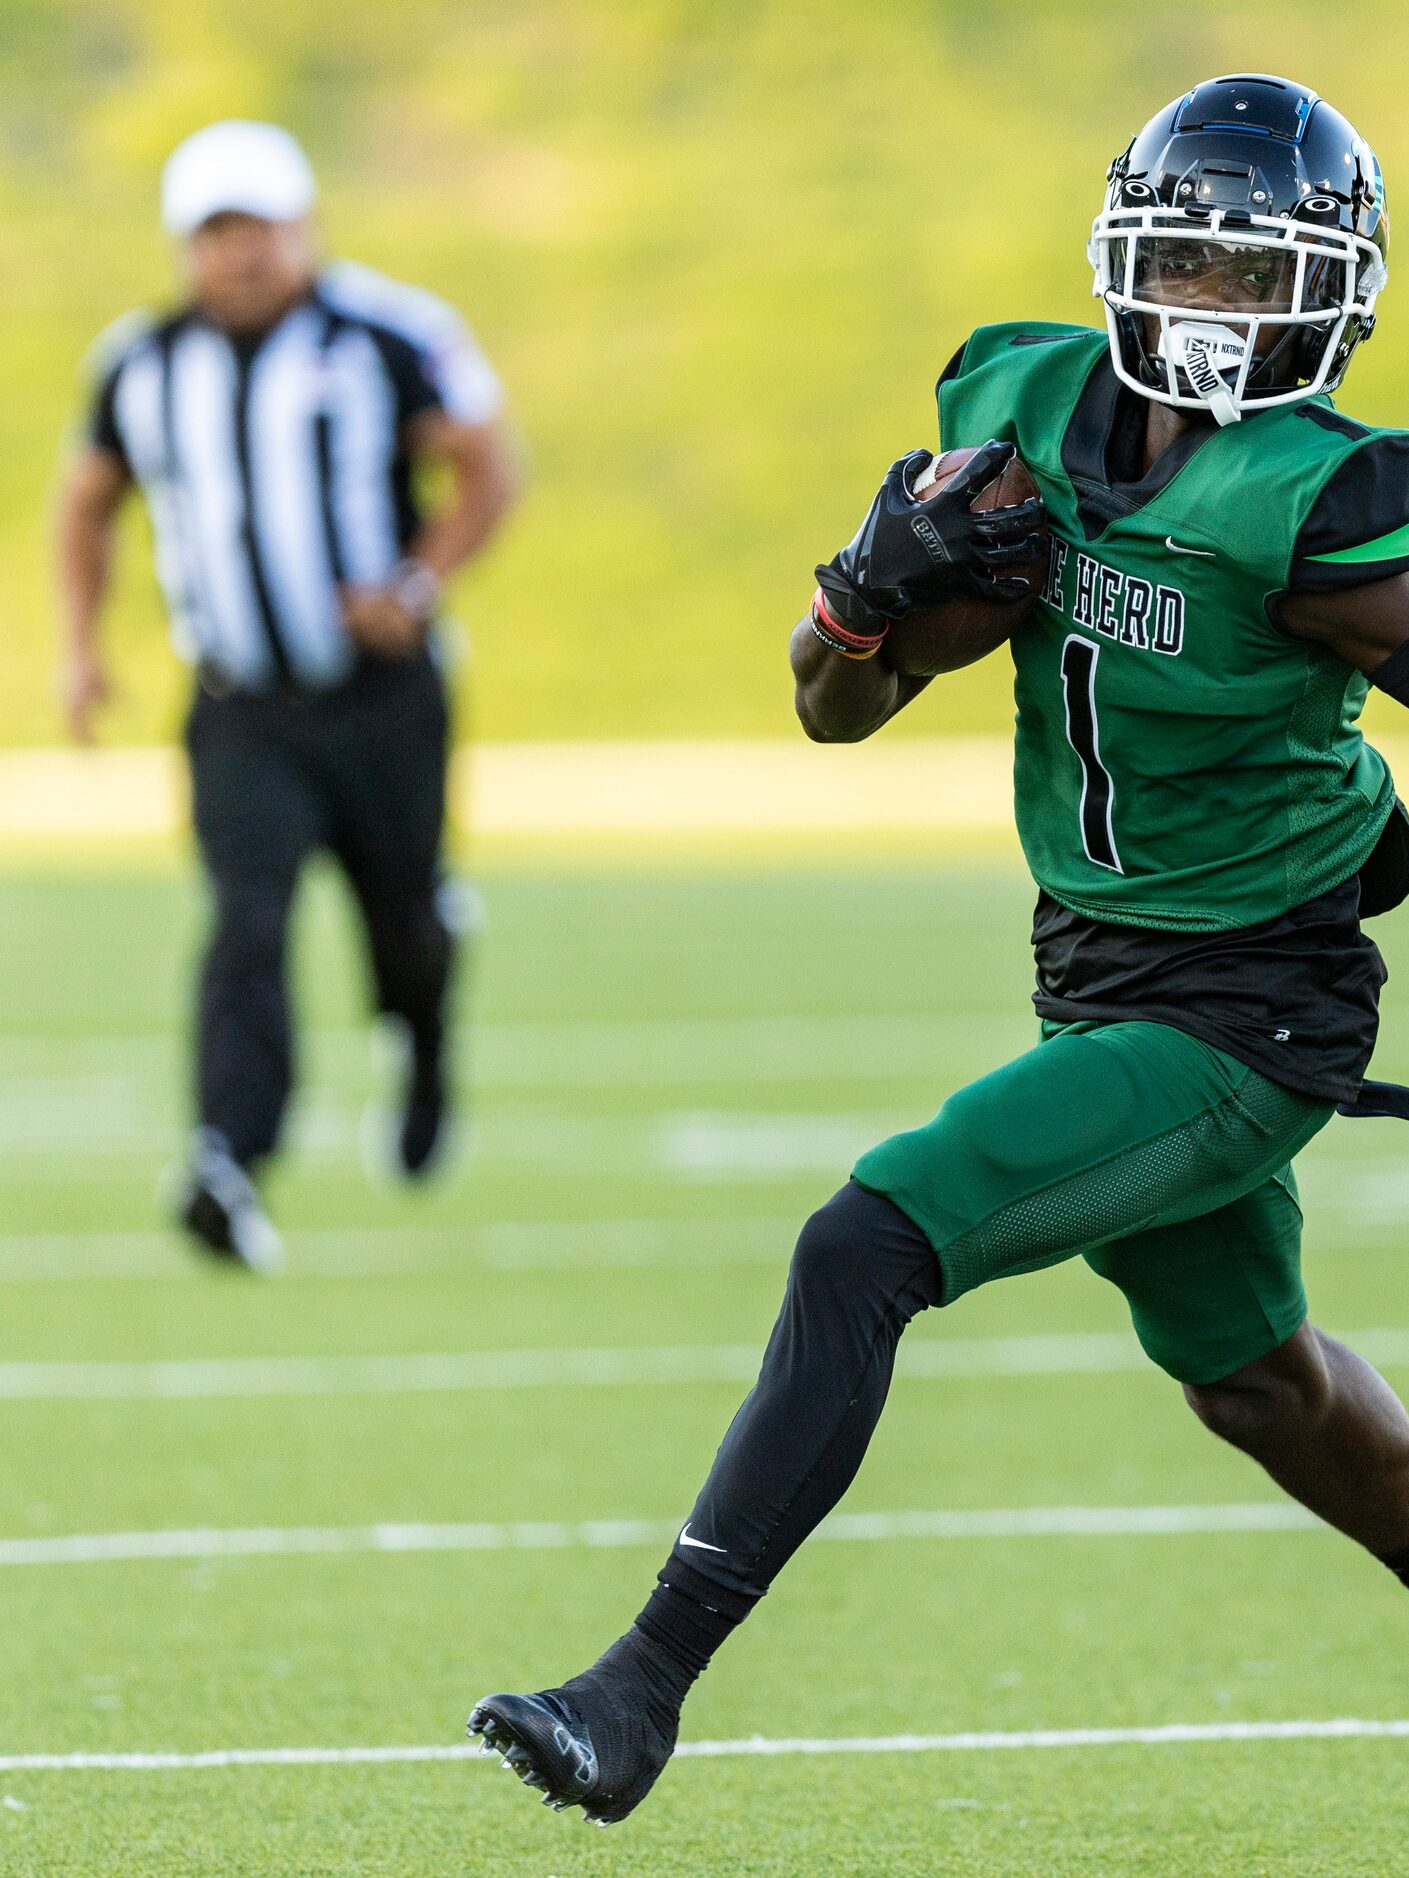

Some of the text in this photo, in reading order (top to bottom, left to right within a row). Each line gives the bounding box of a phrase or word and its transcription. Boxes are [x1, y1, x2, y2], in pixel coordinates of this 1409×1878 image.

[1221, 343, 1245, 357] NXTRND
[1073, 553, 1185, 656] HERD
[1060, 633, 1125, 875] 1
